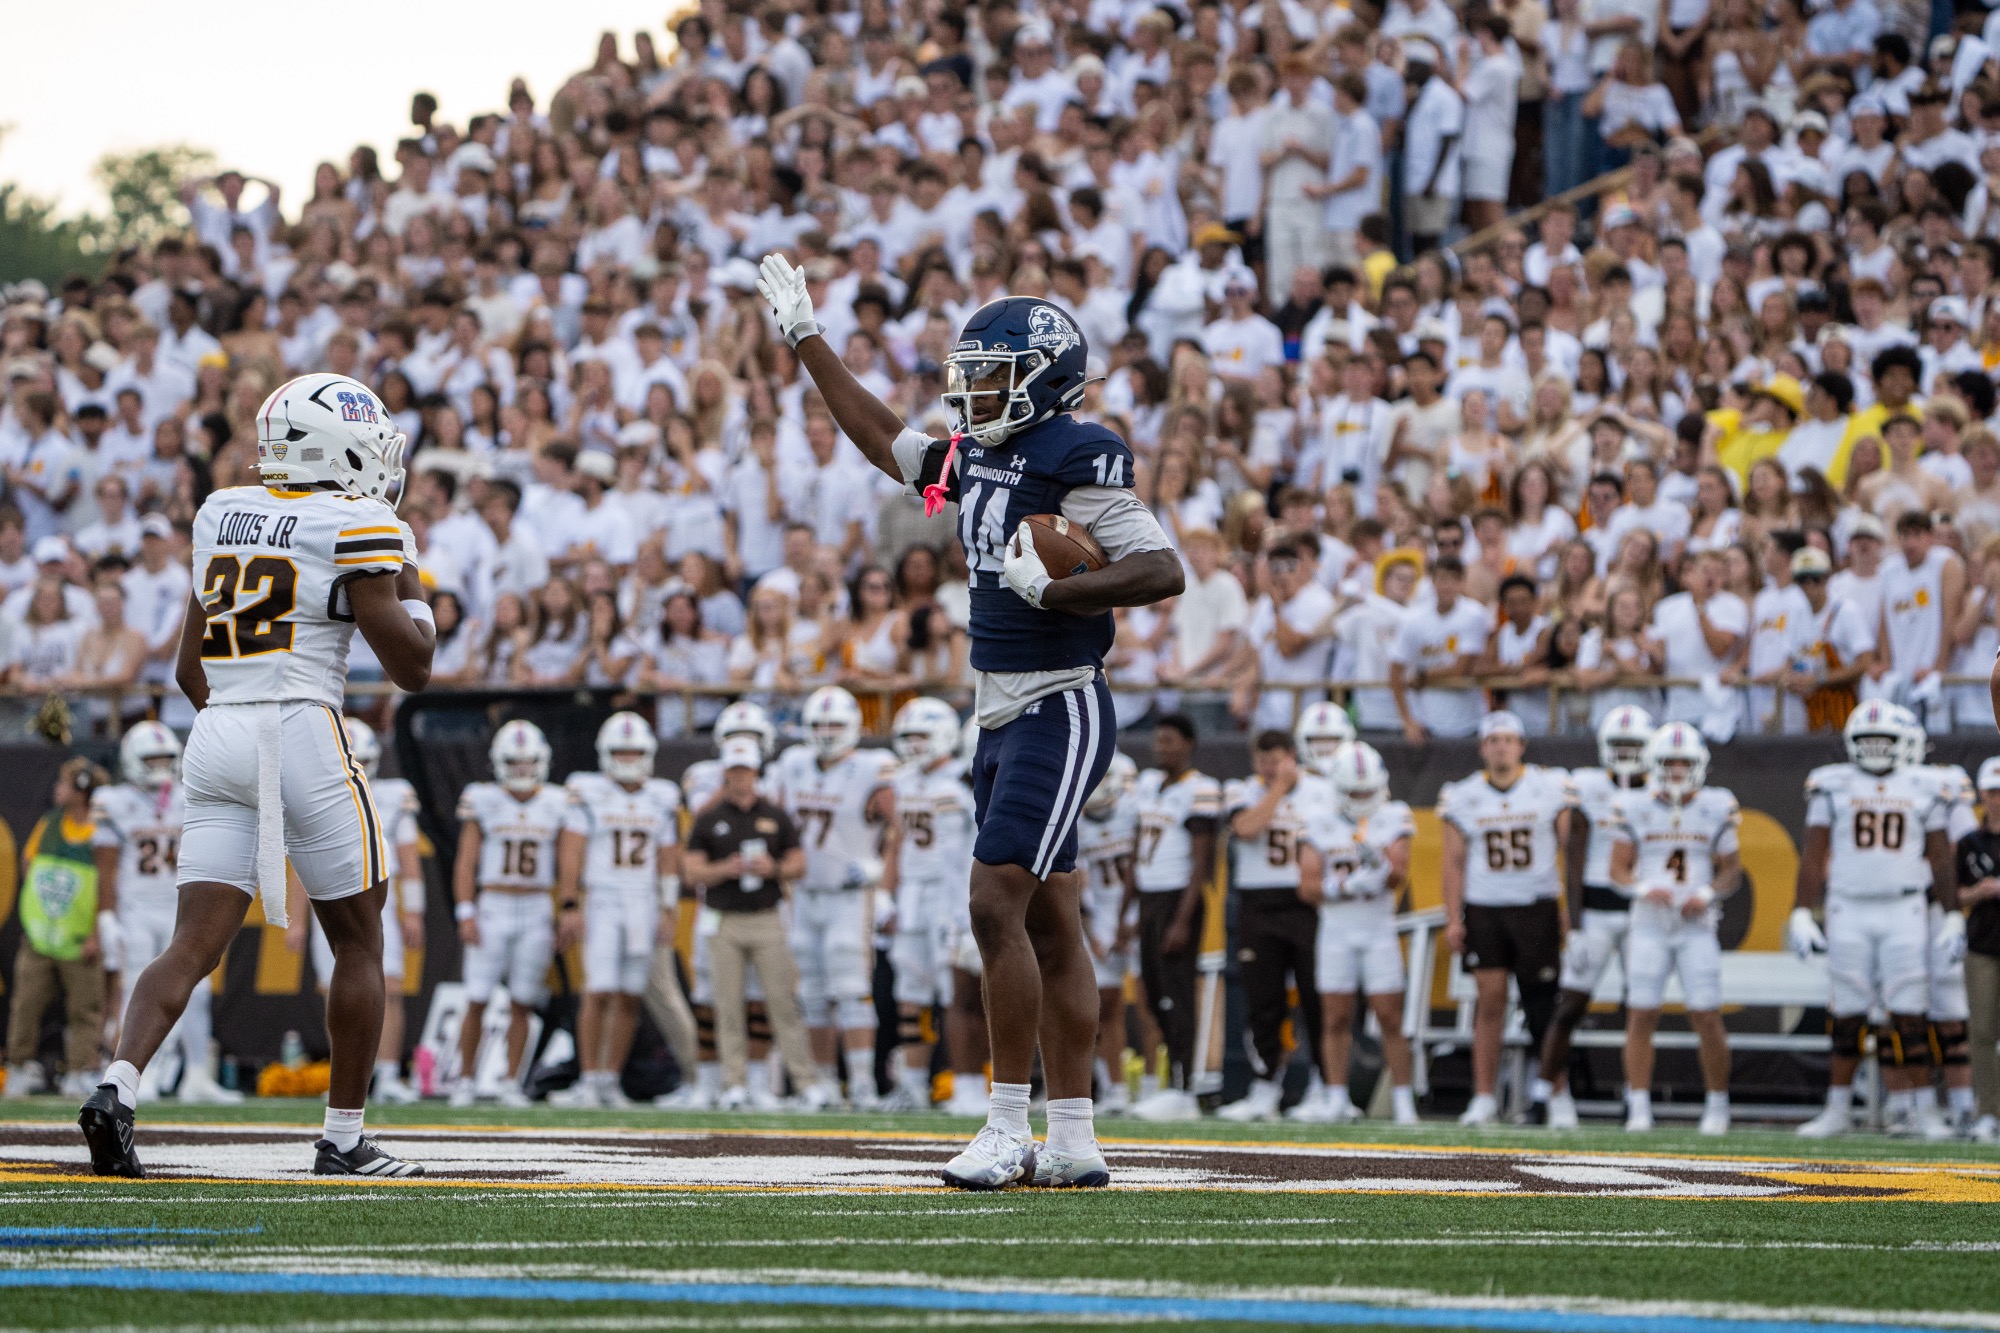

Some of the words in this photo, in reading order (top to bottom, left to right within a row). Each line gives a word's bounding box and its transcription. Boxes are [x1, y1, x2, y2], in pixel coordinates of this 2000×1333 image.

[1031, 332, 1080, 345] MONMOUTH
[337, 392, 378, 424] 22
[968, 448, 984, 458] CAA
[1092, 453, 1124, 487] 14
[967, 463, 1023, 486] MONMOUTH
[217, 512, 268, 545] LOUIS
[267, 515, 298, 548] JR
[959, 481, 1010, 589] 14
[200, 554, 299, 661] 22
[612, 829, 649, 866] 12
[1854, 811, 1905, 850] 60
[503, 839, 540, 876] 16
[1484, 828, 1533, 870] 65
[1666, 848, 1686, 883] 4
